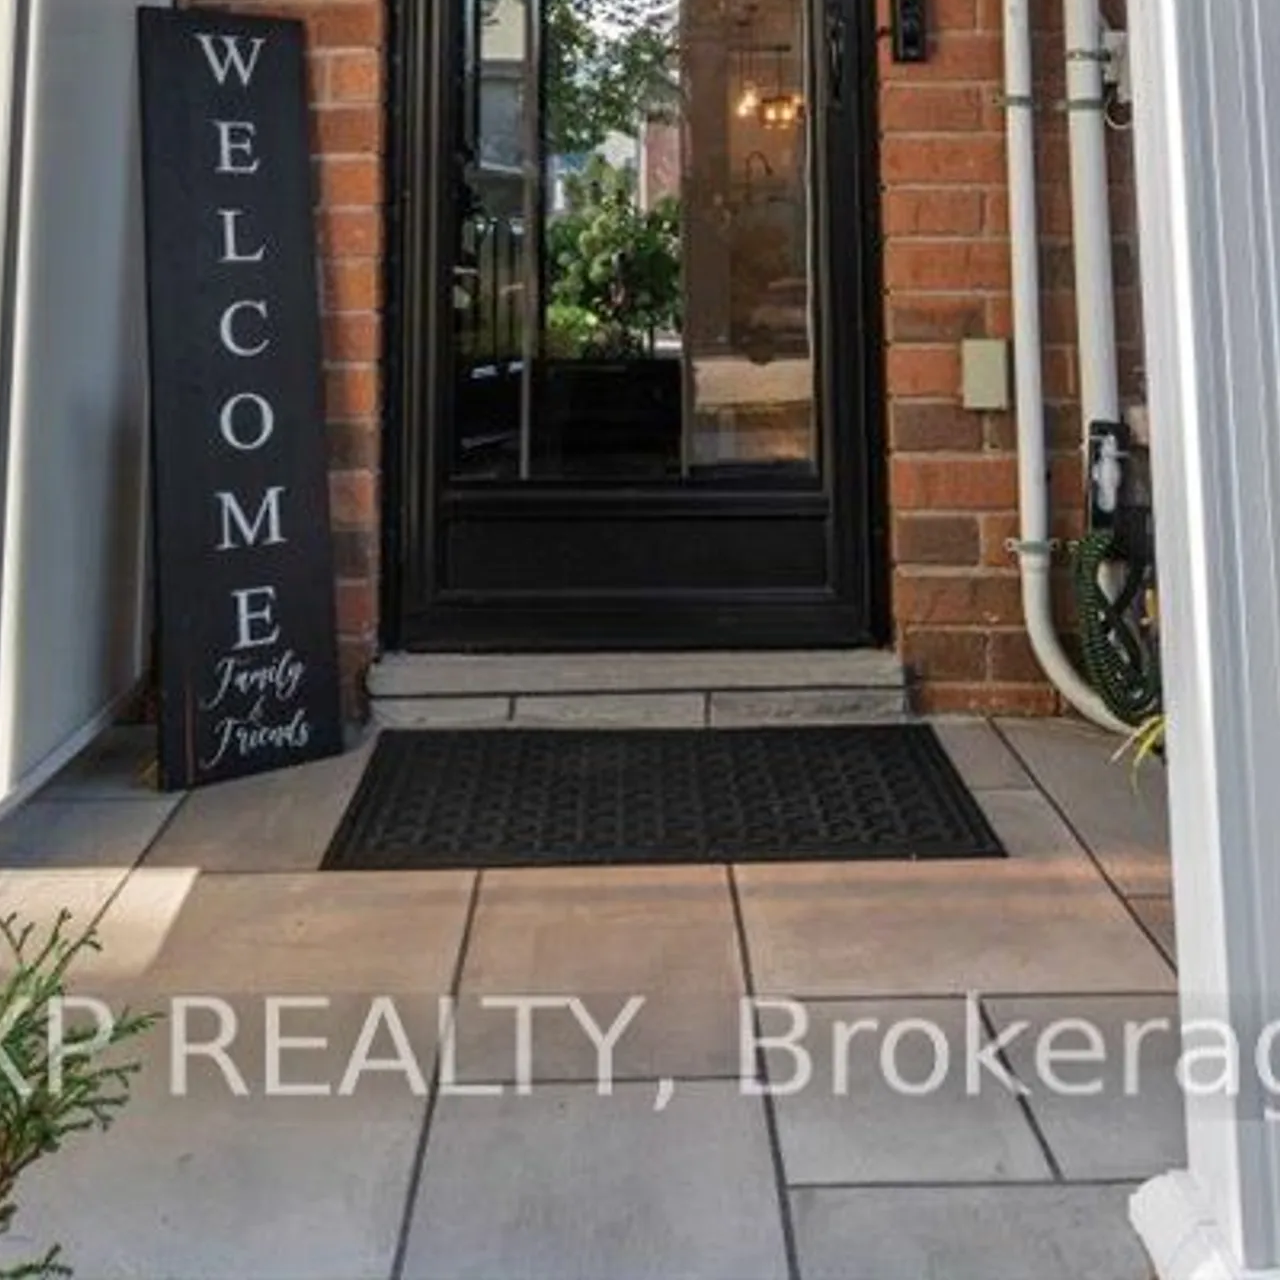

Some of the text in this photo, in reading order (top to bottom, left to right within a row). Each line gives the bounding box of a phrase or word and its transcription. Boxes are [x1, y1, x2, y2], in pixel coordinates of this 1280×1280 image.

[195, 33, 287, 651] WELCOME
[200, 649, 304, 710] Family
[200, 708, 310, 769] Friends
